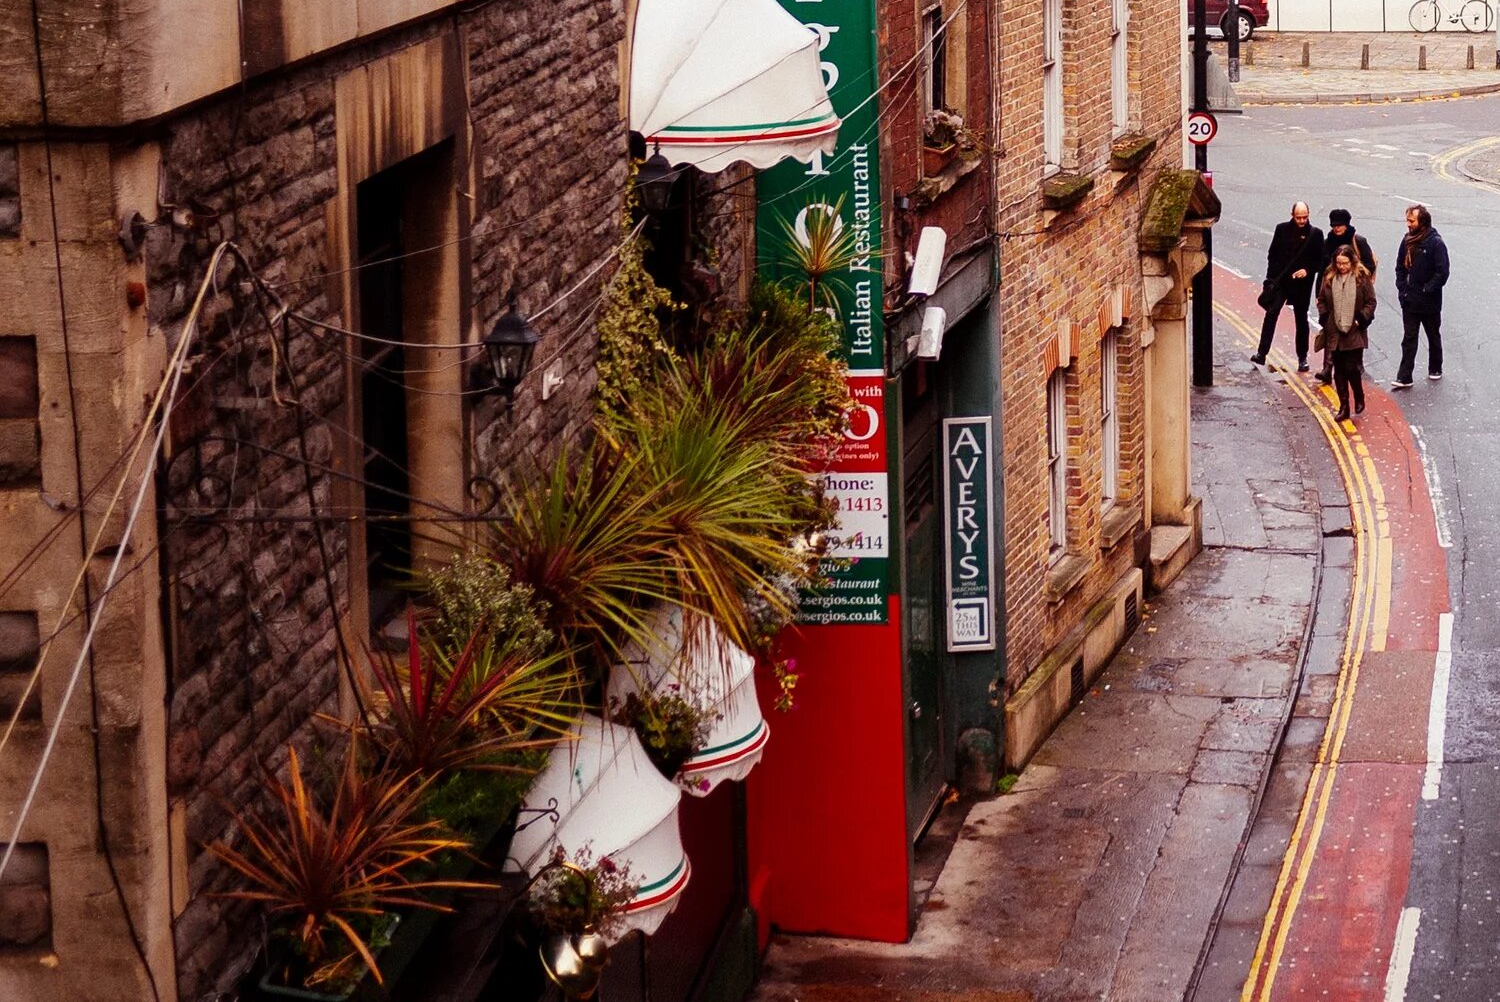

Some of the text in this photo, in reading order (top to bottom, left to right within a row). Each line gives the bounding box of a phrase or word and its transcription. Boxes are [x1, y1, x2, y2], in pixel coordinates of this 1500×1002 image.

[1189, 122, 1211, 136] 20
[849, 142, 872, 356] Italian Restaurant
[854, 385, 883, 397] with
[858, 451, 879, 461] only)
[951, 427, 983, 579] AVERYS
[956, 621, 978, 630] THIS
[956, 629, 978, 637] WAY
